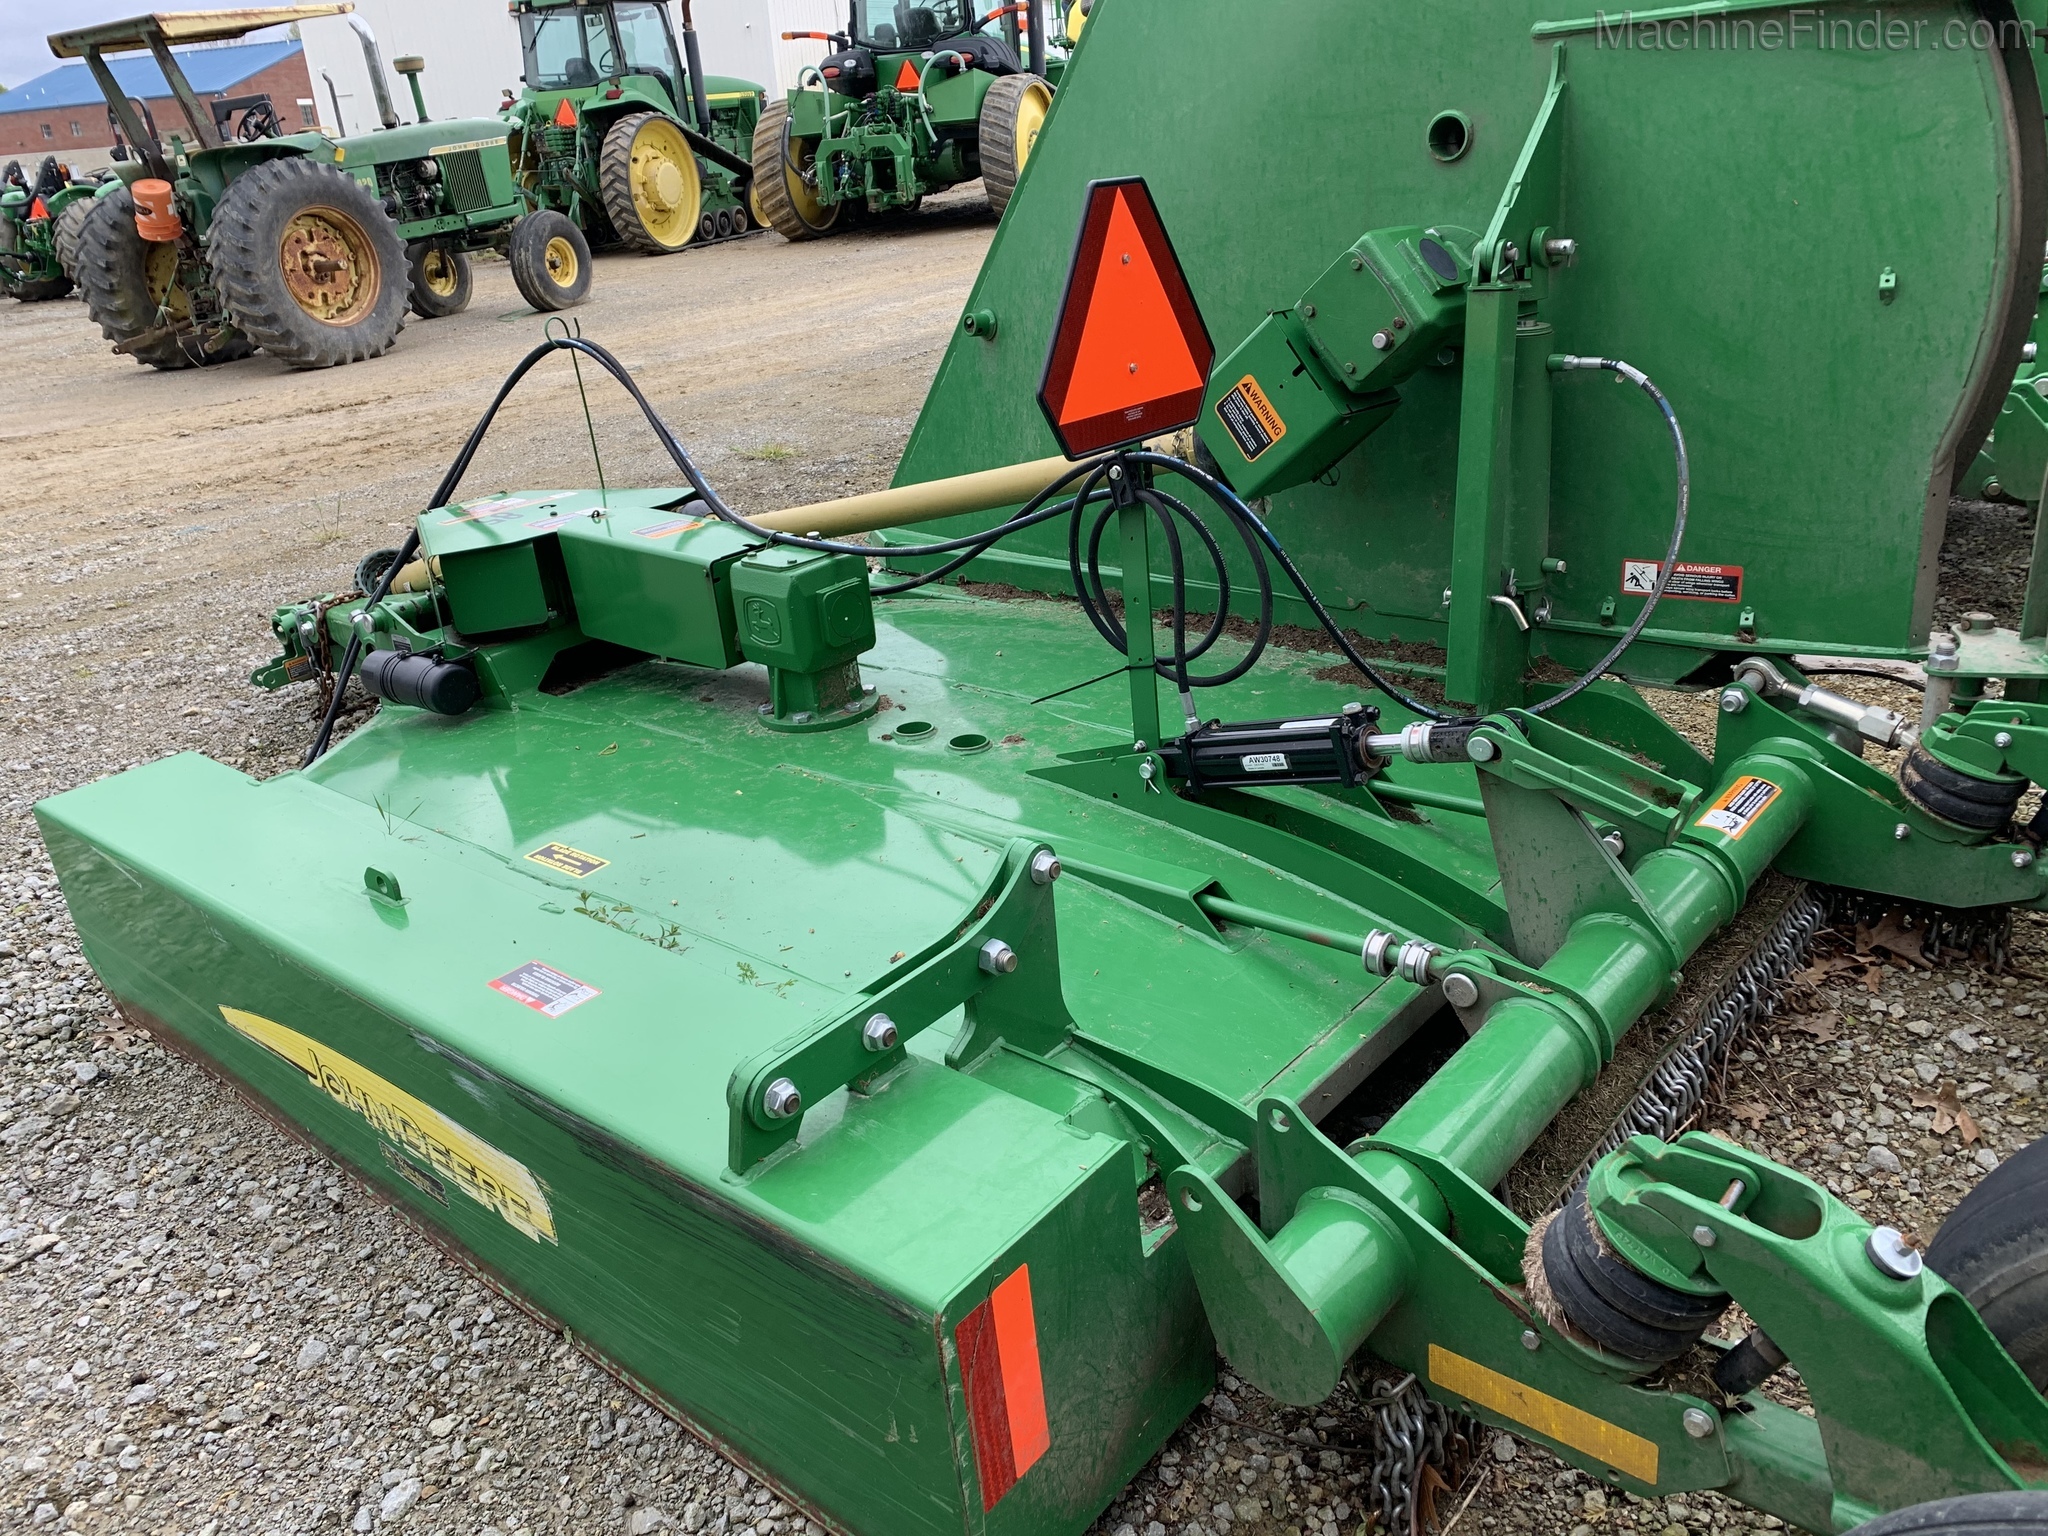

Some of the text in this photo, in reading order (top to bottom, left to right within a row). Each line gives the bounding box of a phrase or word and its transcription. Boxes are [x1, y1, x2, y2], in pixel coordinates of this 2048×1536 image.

[1250, 389, 1282, 437] WARNING
[1686, 565, 1722, 573] DANGER
[1248, 755, 1281, 763] AW30748
[308, 1048, 396, 1138] JOHN
[391, 1103, 540, 1244] DEERE
